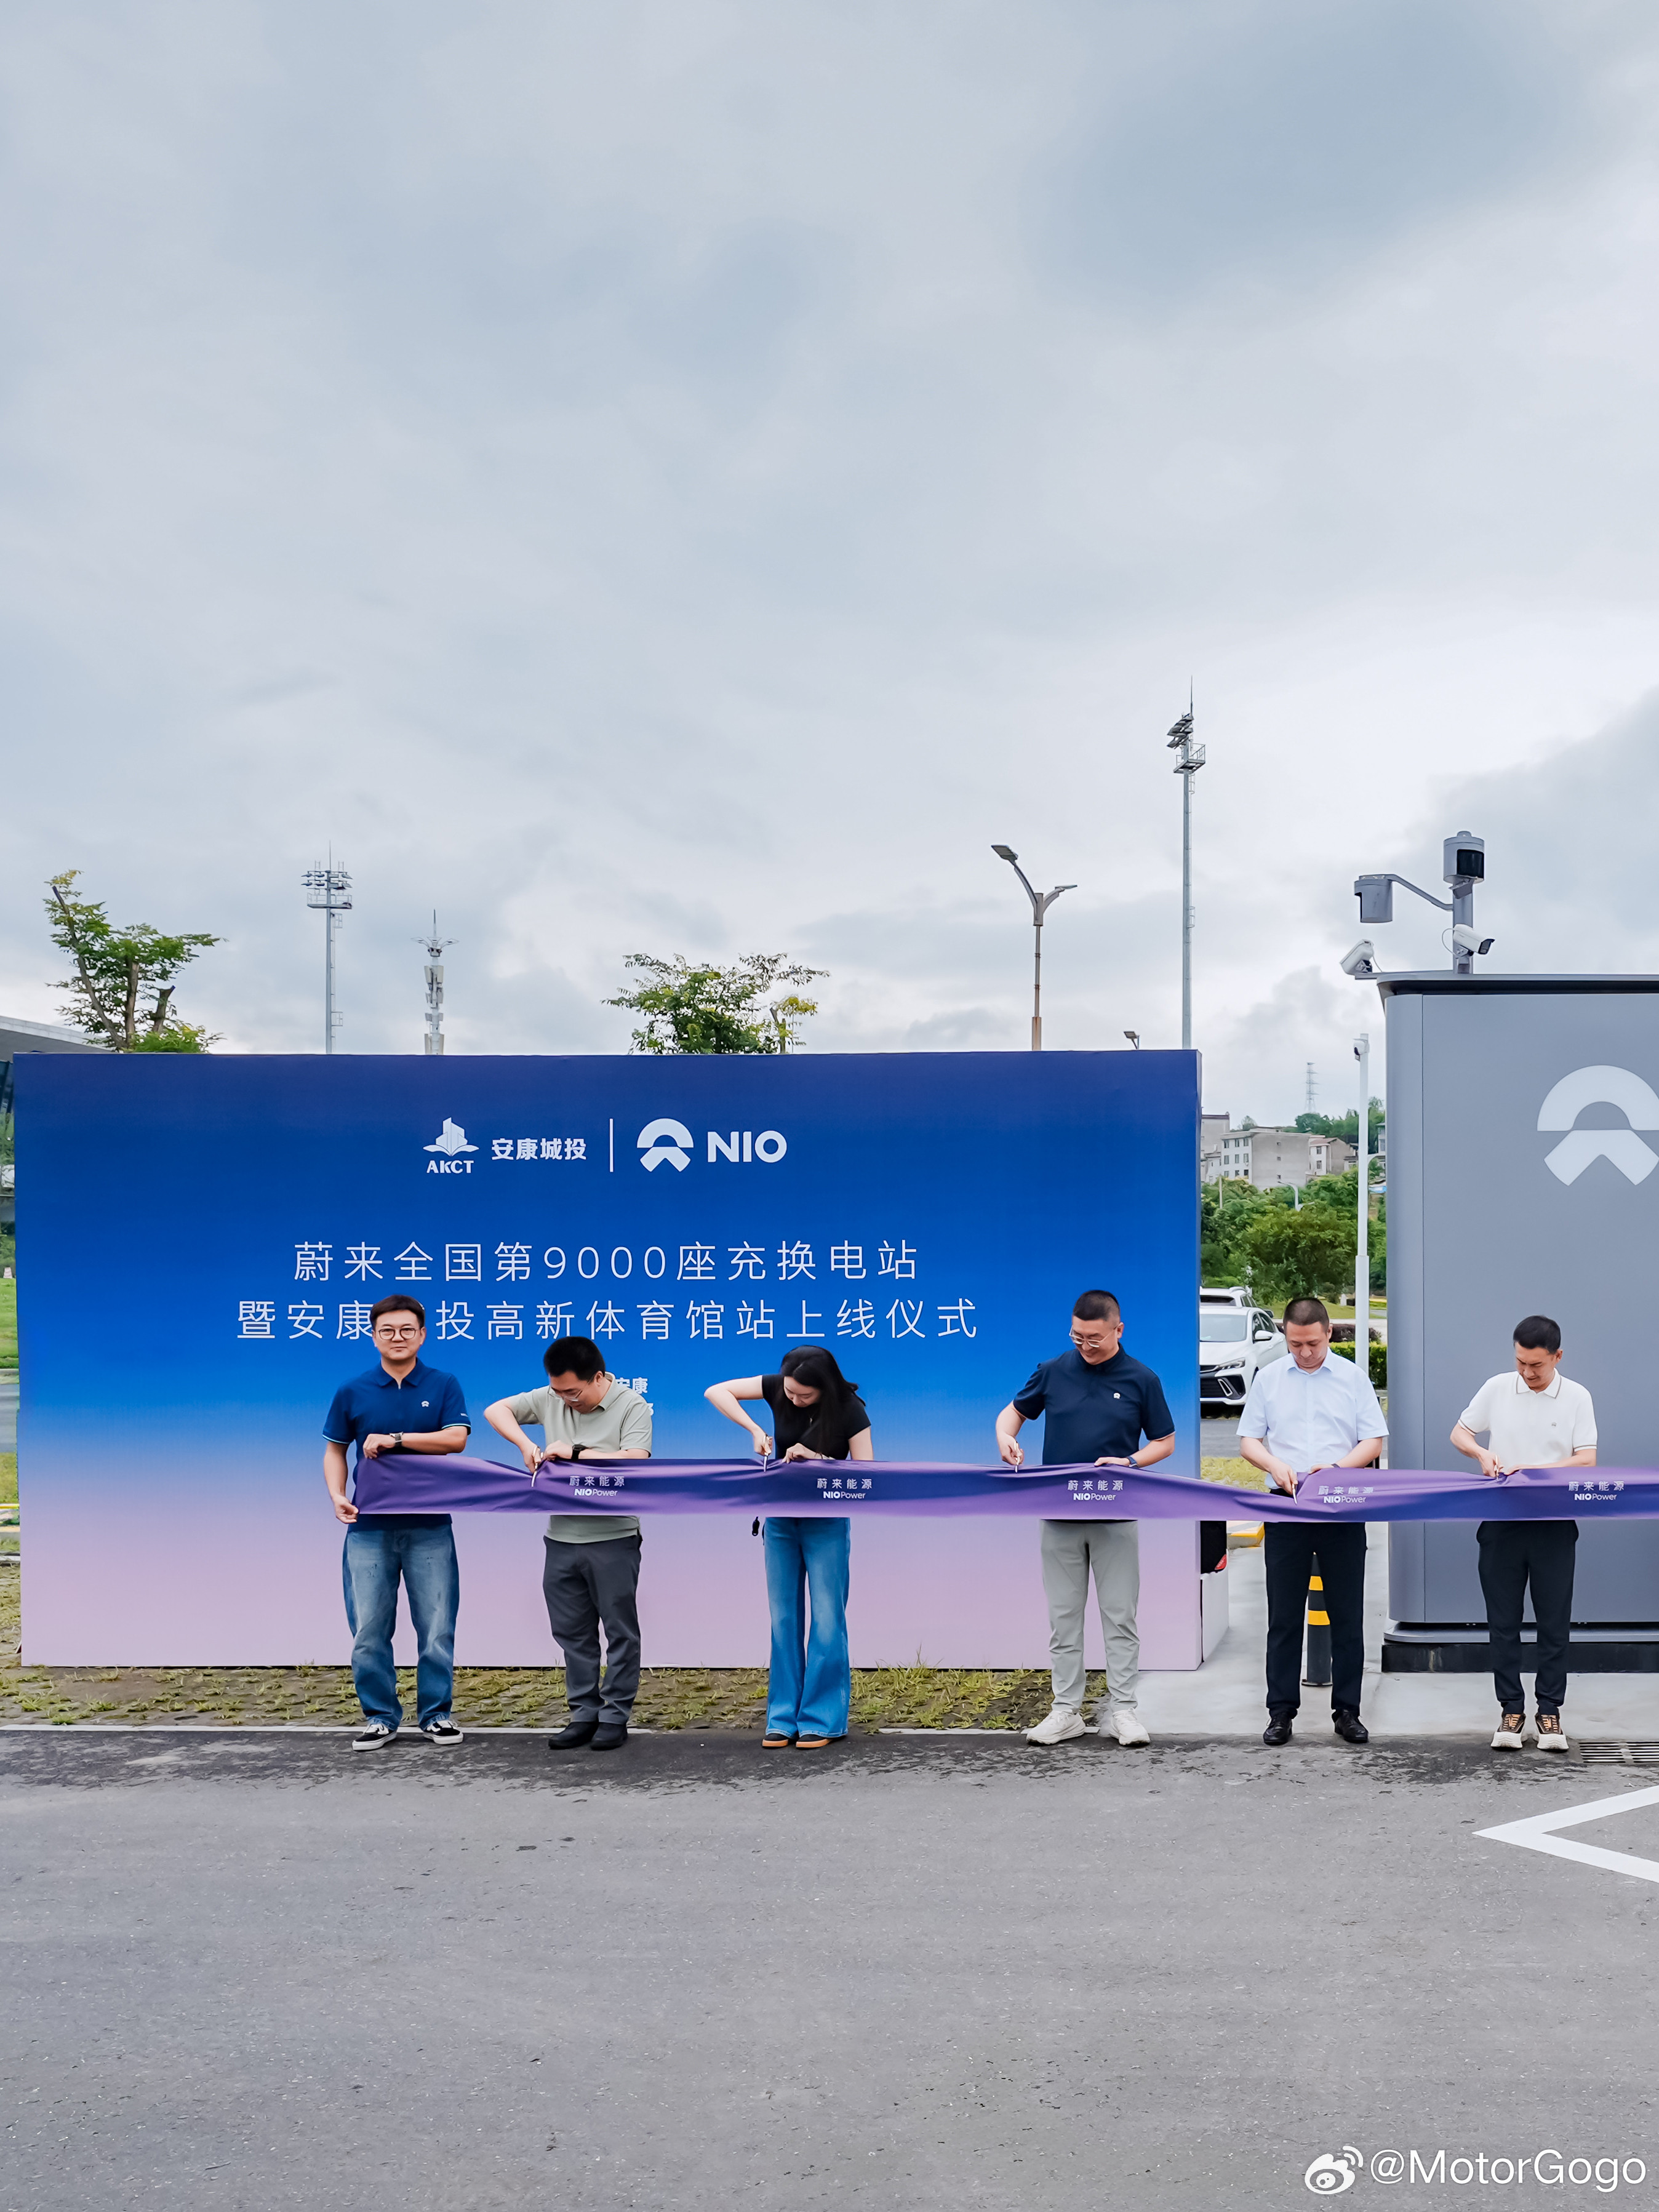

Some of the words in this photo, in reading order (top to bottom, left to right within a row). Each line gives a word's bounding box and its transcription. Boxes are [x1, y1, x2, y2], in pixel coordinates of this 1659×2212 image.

[491, 1138, 586, 1160] 安康城投
[707, 1130, 787, 1163] NIO
[426, 1160, 474, 1174] AKCT
[294, 1239, 917, 1282] 蔚来全国第9000座充换电站
[237, 1298, 977, 1340] 暨安康投高新体育馆站上线仪式
[569, 1475, 625, 1487] 蔚来能源
[817, 1478, 872, 1490] 蔚来能源
[1067, 1480, 1123, 1491] 蔚来能源
[1569, 1481, 1625, 1491] 蔚来能源
[1318, 1485, 1374, 1495] 蔚来能源
